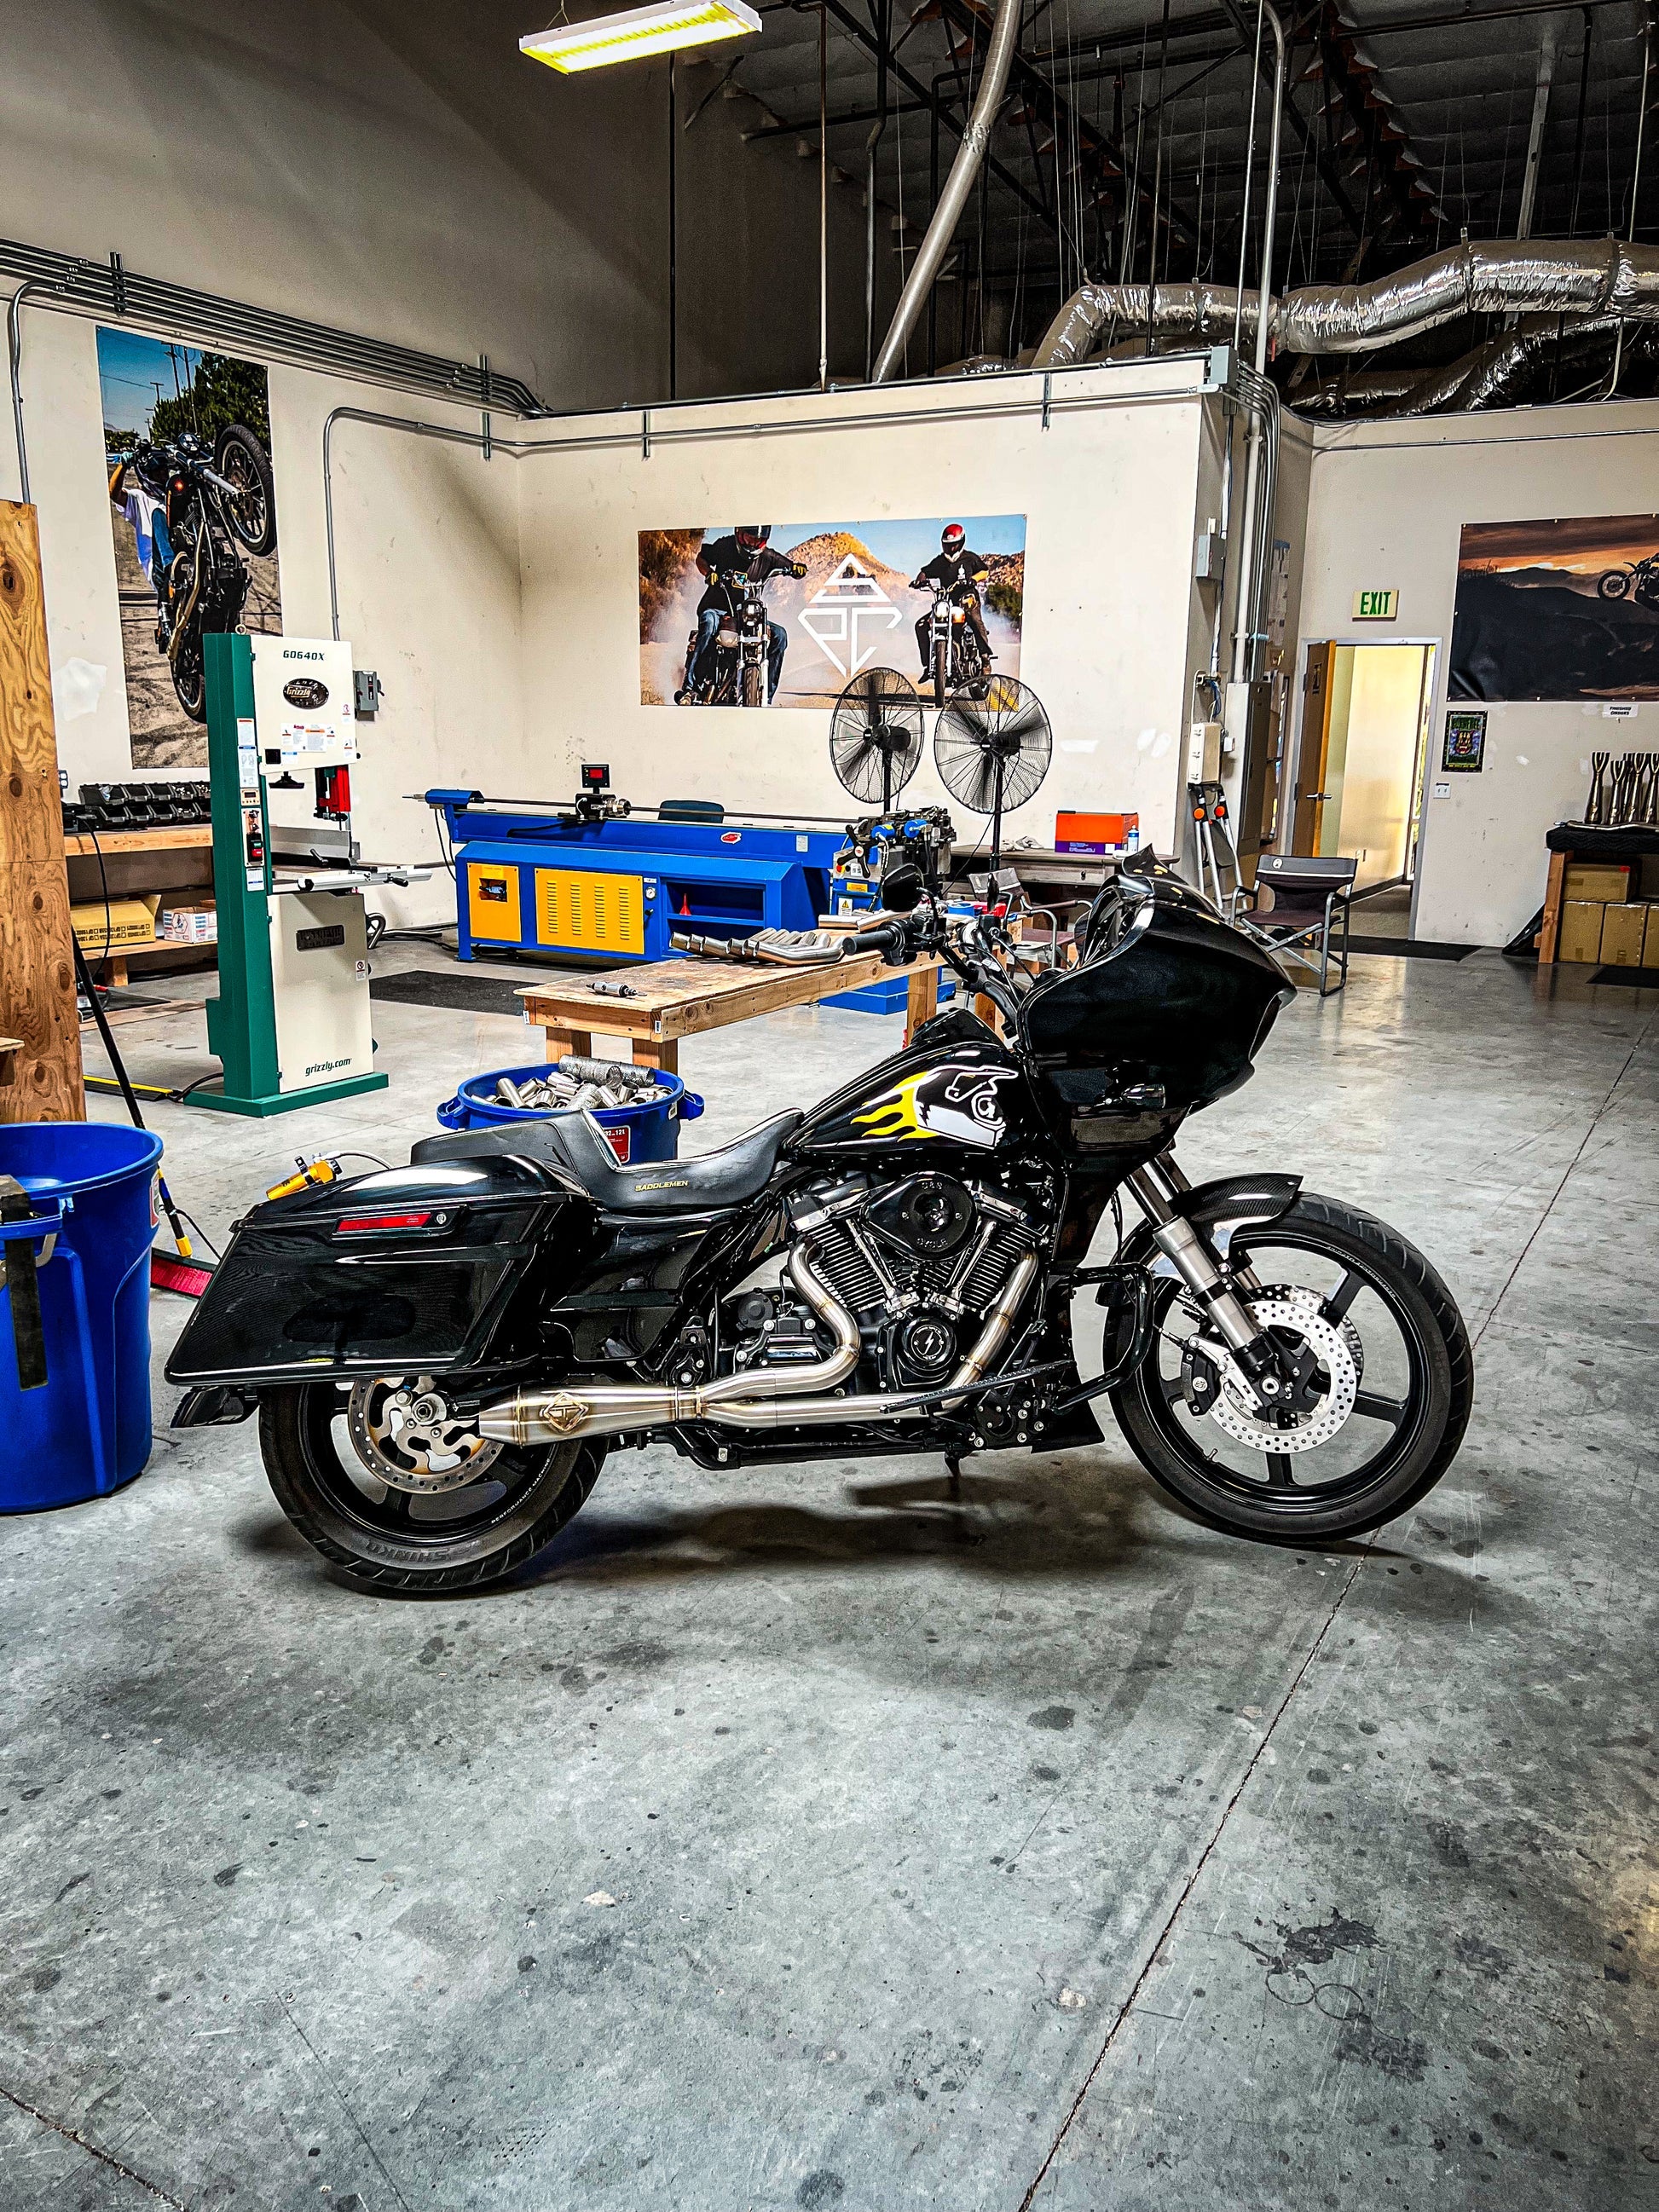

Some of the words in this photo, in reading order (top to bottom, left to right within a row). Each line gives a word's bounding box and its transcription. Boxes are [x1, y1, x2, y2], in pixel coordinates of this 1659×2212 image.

[1360, 591, 1392, 615] EXIT
[304, 1057, 353, 1078] grizzly.com
[634, 1180, 689, 1192] SADDLEMEN
[490, 1487, 533, 1524] PERFORMANCE
[532, 1458, 551, 1487] MACHINE
